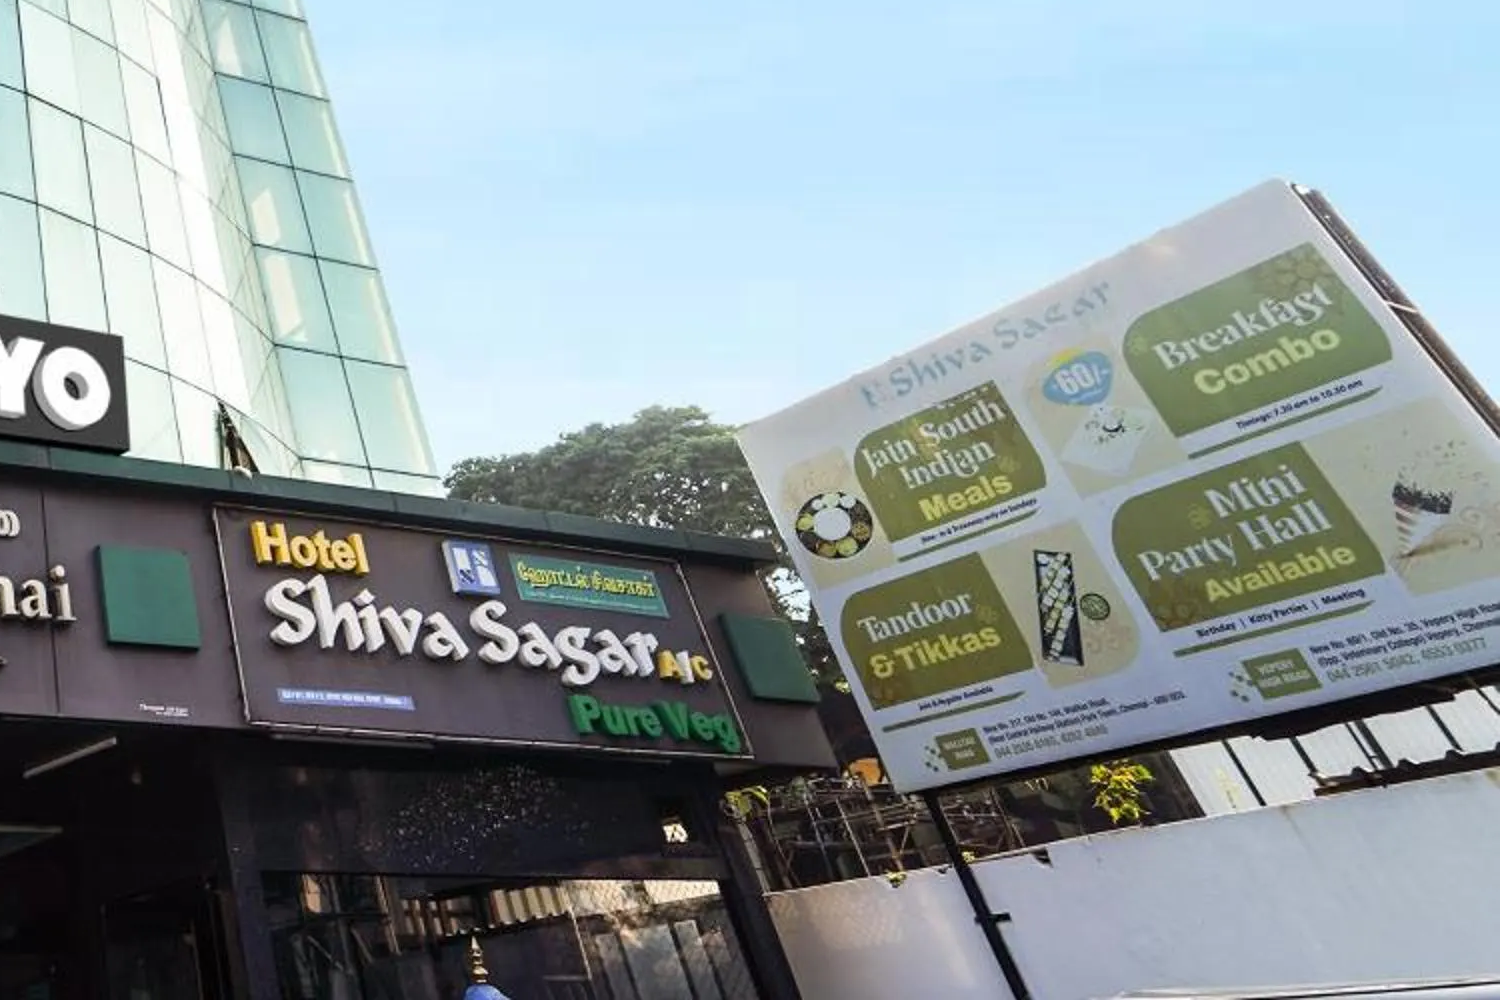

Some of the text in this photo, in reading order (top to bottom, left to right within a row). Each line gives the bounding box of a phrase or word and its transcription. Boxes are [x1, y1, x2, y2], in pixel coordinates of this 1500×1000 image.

[1151, 281, 1333, 370] Breakfast
[890, 340, 993, 397] Shiva
[1193, 328, 1341, 396] Combo
[861, 400, 1007, 480] Jain South
[898, 440, 996, 490] Indian
[918, 474, 1013, 522] Meals
[1204, 463, 1308, 519] Mini
[250, 520, 370, 578] Hotel
[1136, 498, 1333, 582] Party Hall
[1204, 545, 1357, 604] Available
[264, 573, 470, 663] Shiva
[469, 599, 659, 687] Sagar
[856, 593, 973, 643] Tandoor
[894, 627, 1001, 671] Tikkas
[567, 692, 741, 752] Pure Veg
